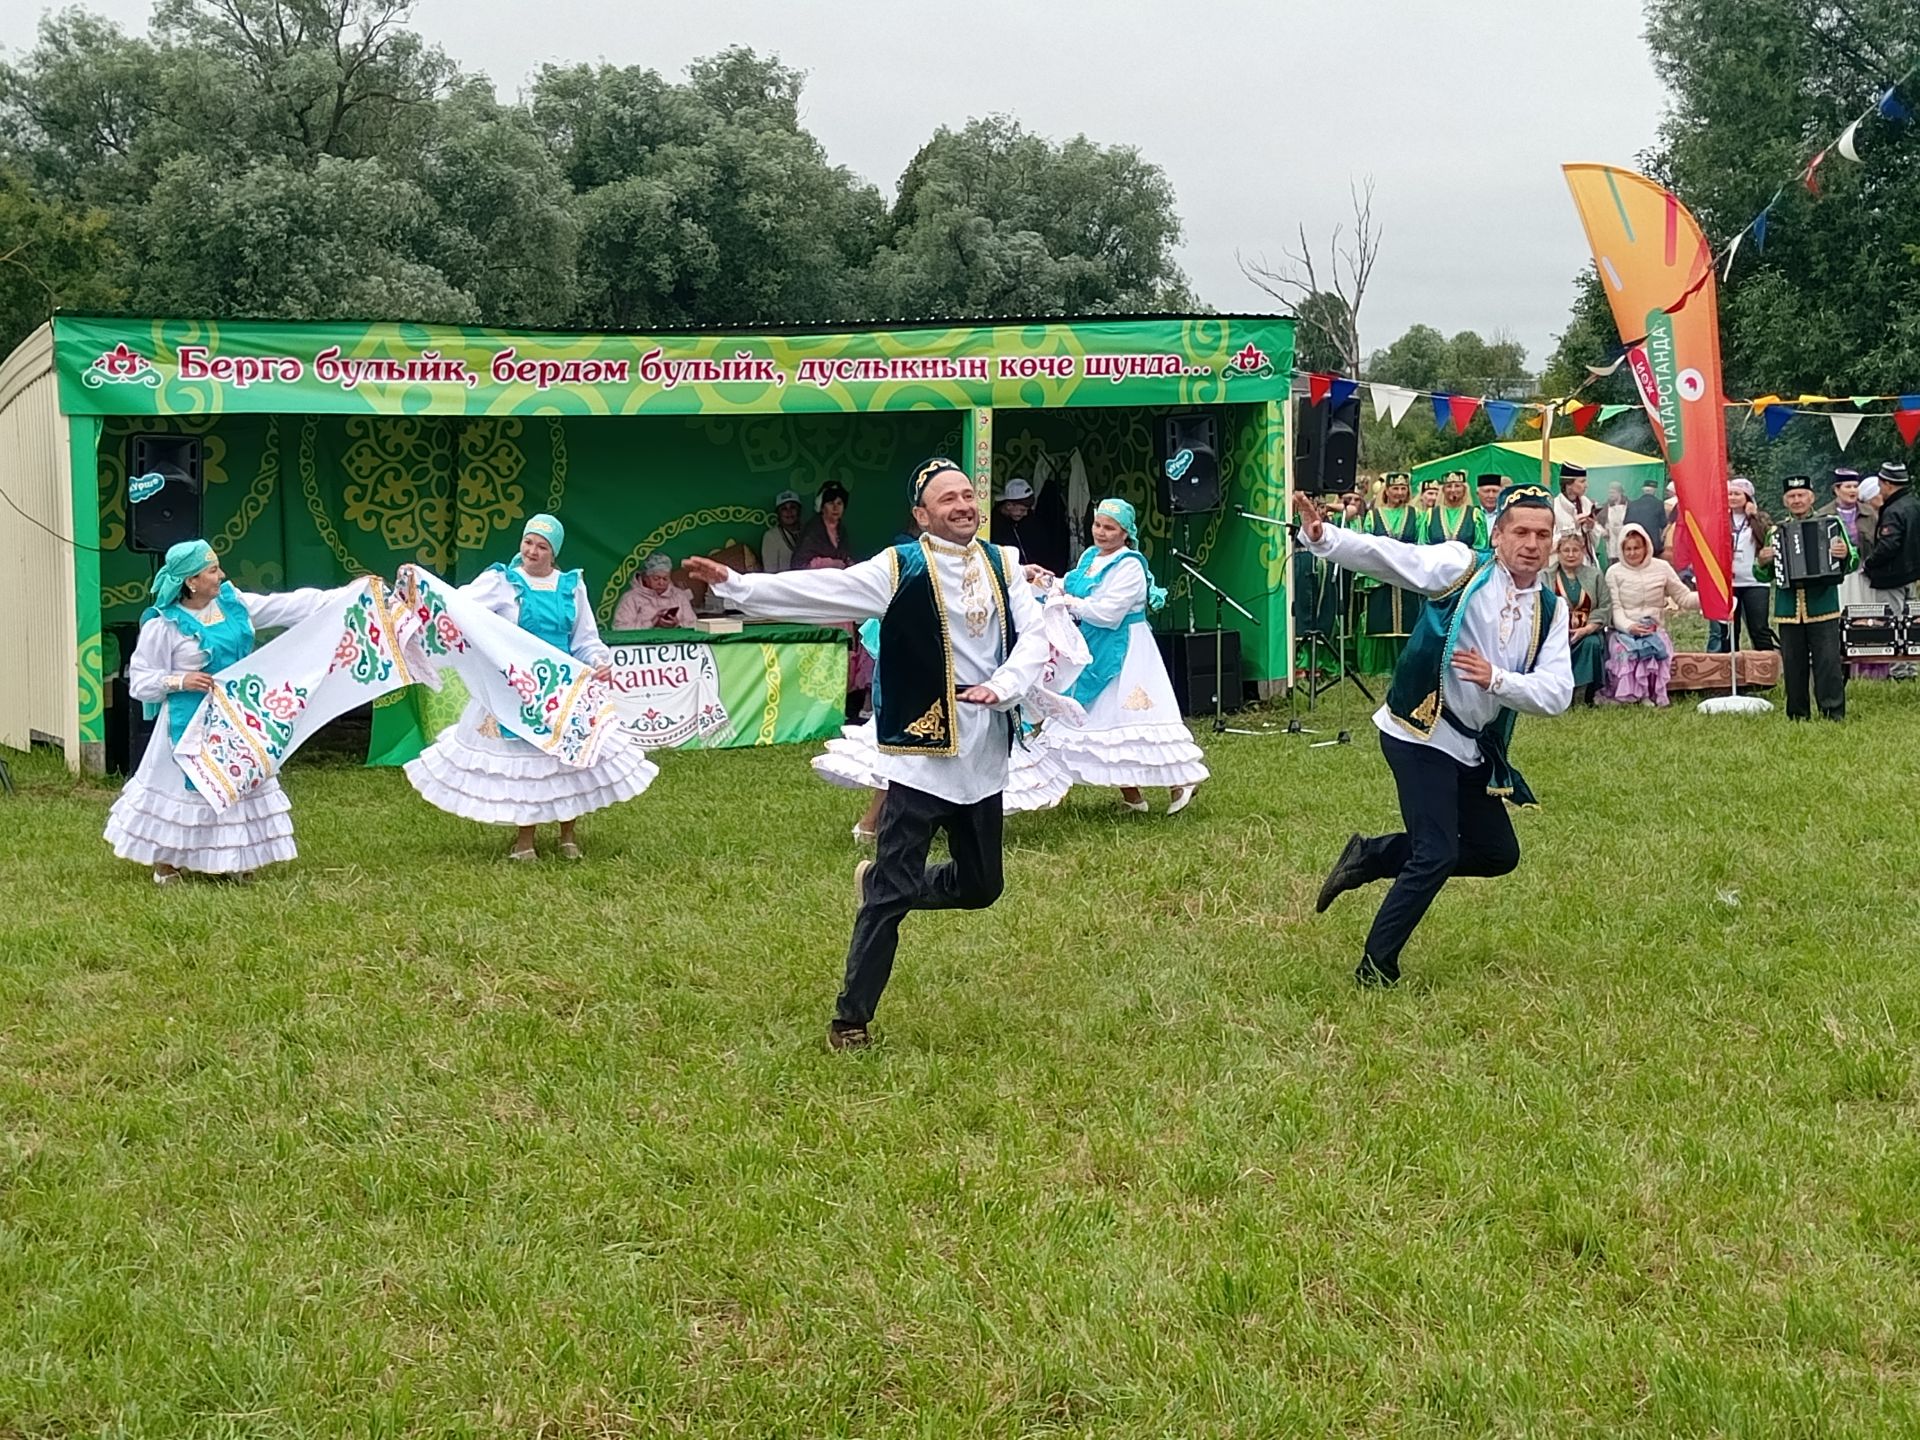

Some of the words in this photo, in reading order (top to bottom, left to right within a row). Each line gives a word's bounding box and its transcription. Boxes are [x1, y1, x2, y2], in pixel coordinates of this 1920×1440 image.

[177, 347, 303, 387] Бергә
[315, 346, 477, 388] булыйк,
[492, 349, 628, 388] бердәм
[640, 350, 785, 388] булыйк,
[797, 358, 988, 387] дуслыкның
[999, 356, 1074, 378] көче
[1084, 355, 1211, 382] шунда...
[1651, 326, 1678, 447] ТАТАРСТАНДА
[613, 642, 699, 667] өлгеле
[607, 665, 689, 693] капка
